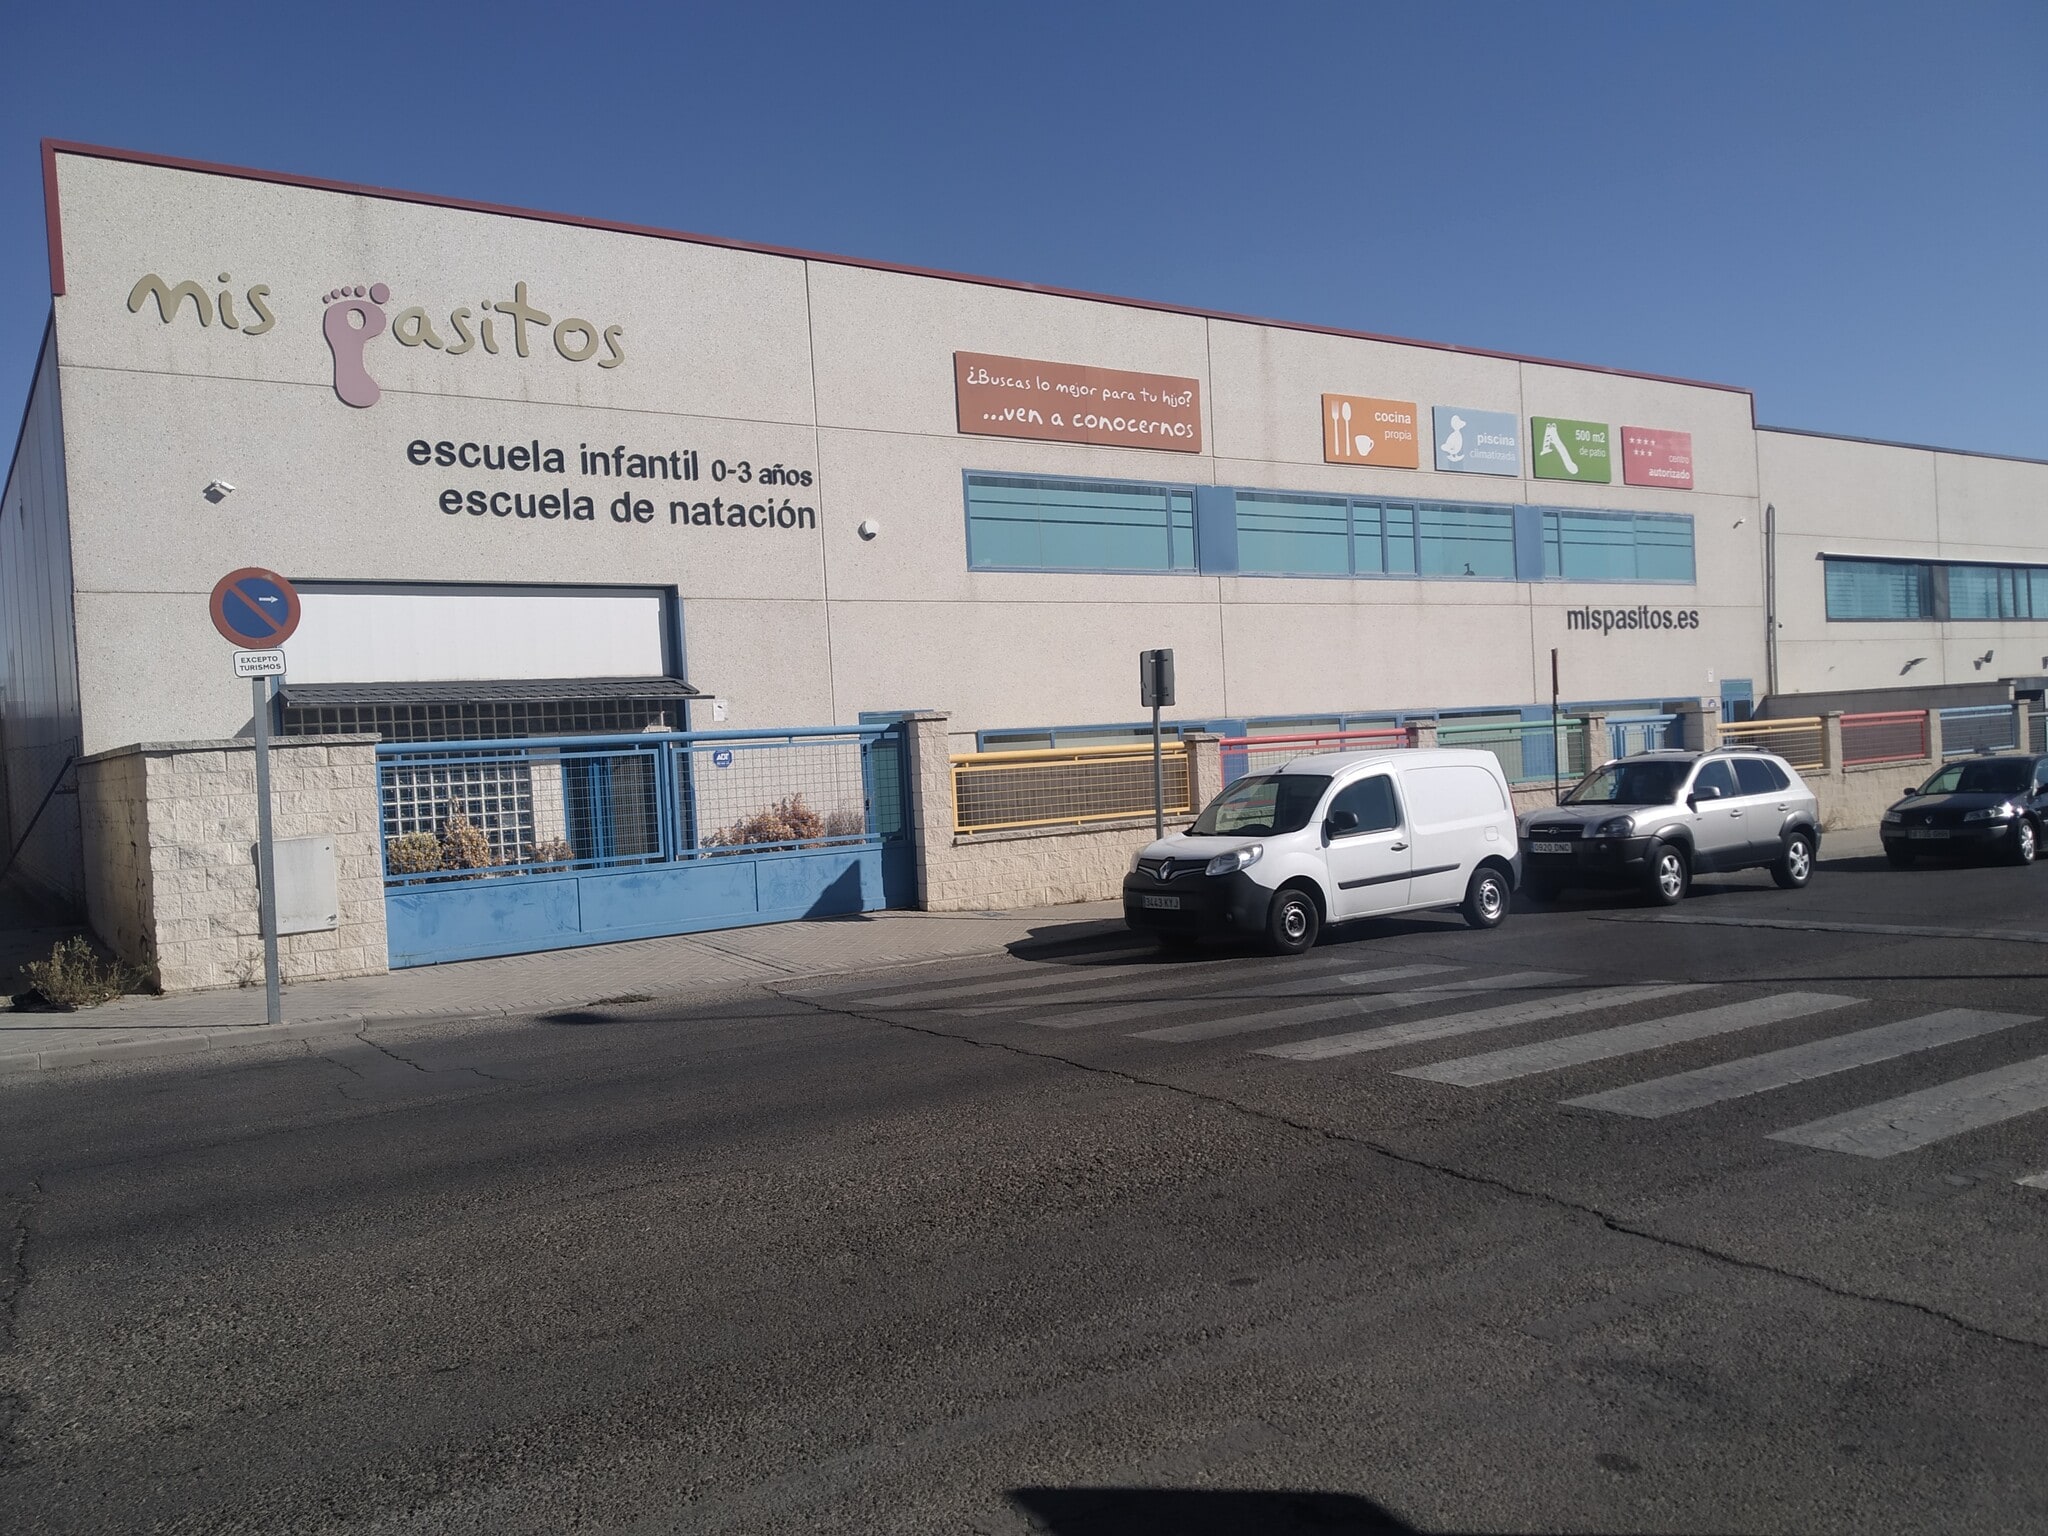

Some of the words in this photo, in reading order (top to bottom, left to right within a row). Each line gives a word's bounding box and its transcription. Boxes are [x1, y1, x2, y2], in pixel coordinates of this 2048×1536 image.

[127, 272, 276, 335] mis
[966, 366, 1031, 388] ¿Buscas
[1036, 376, 1050, 391] lo
[1056, 383, 1097, 398] mejor
[1102, 388, 1136, 401] para
[1140, 387, 1158, 402] tu
[1162, 390, 1192, 408] hijo?
[1374, 411, 1412, 425] cocina
[1050, 413, 1064, 427] a
[1072, 412, 1194, 439] conocernos
[1384, 429, 1412, 442] propia
[1477, 432, 1516, 447] piscina
[1575, 429, 1590, 442] 500
[1592, 432, 1606, 443] m2
[1469, 448, 1516, 462] climatizada
[1579, 446, 1589, 456] de
[1589, 447, 1606, 459] patio
[1668, 453, 1690, 465] centro
[407, 439, 566, 474] escuela
[580, 442, 701, 481] infantil
[711, 460, 753, 483] 0-3
[758, 462, 813, 488] años
[1648, 467, 1691, 480] autorizado
[438, 486, 596, 522] escuela
[610, 489, 656, 524] de
[669, 495, 817, 530] natación
[1567, 605, 1700, 636] mispasitos.es
[240, 655, 279, 664] EXCEPTO
[239, 663, 283, 672] TURISMOS
